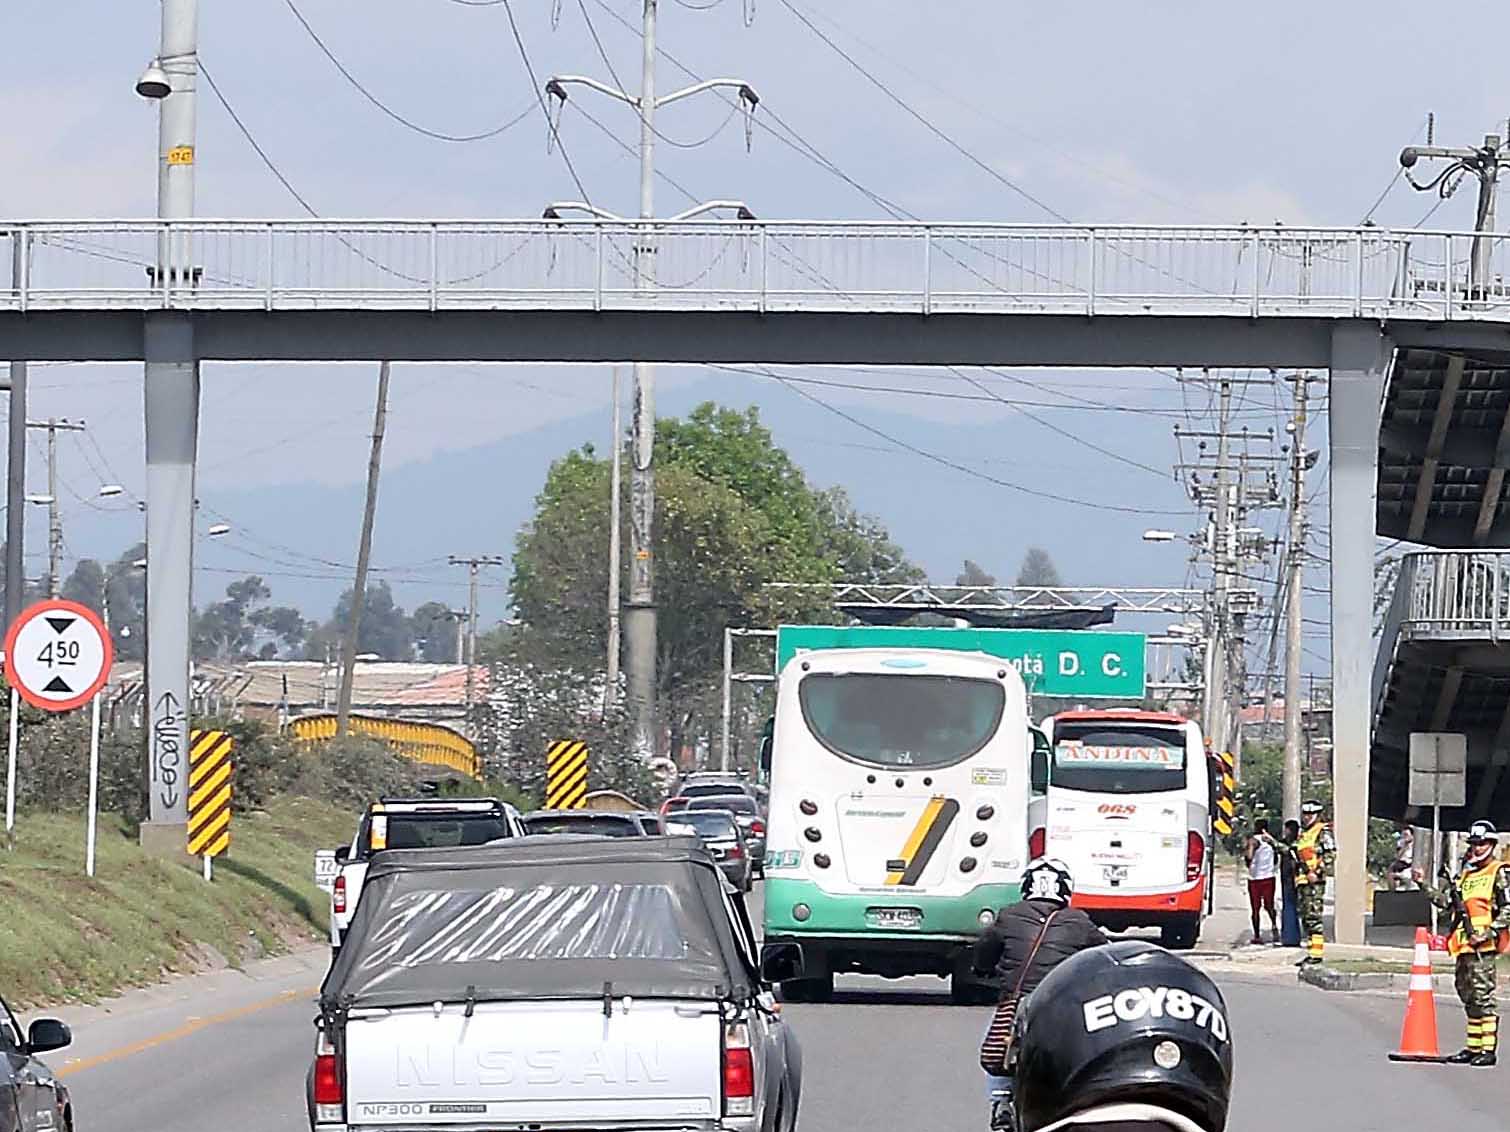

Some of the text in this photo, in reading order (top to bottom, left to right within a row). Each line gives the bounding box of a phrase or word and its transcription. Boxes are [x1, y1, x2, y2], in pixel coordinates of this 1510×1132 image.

[1066, 746, 1170, 762] ANDINA
[1083, 986, 1228, 1043] ECY87D
[394, 1044, 669, 1088] NISSAN
[363, 1104, 423, 1115] NP300
